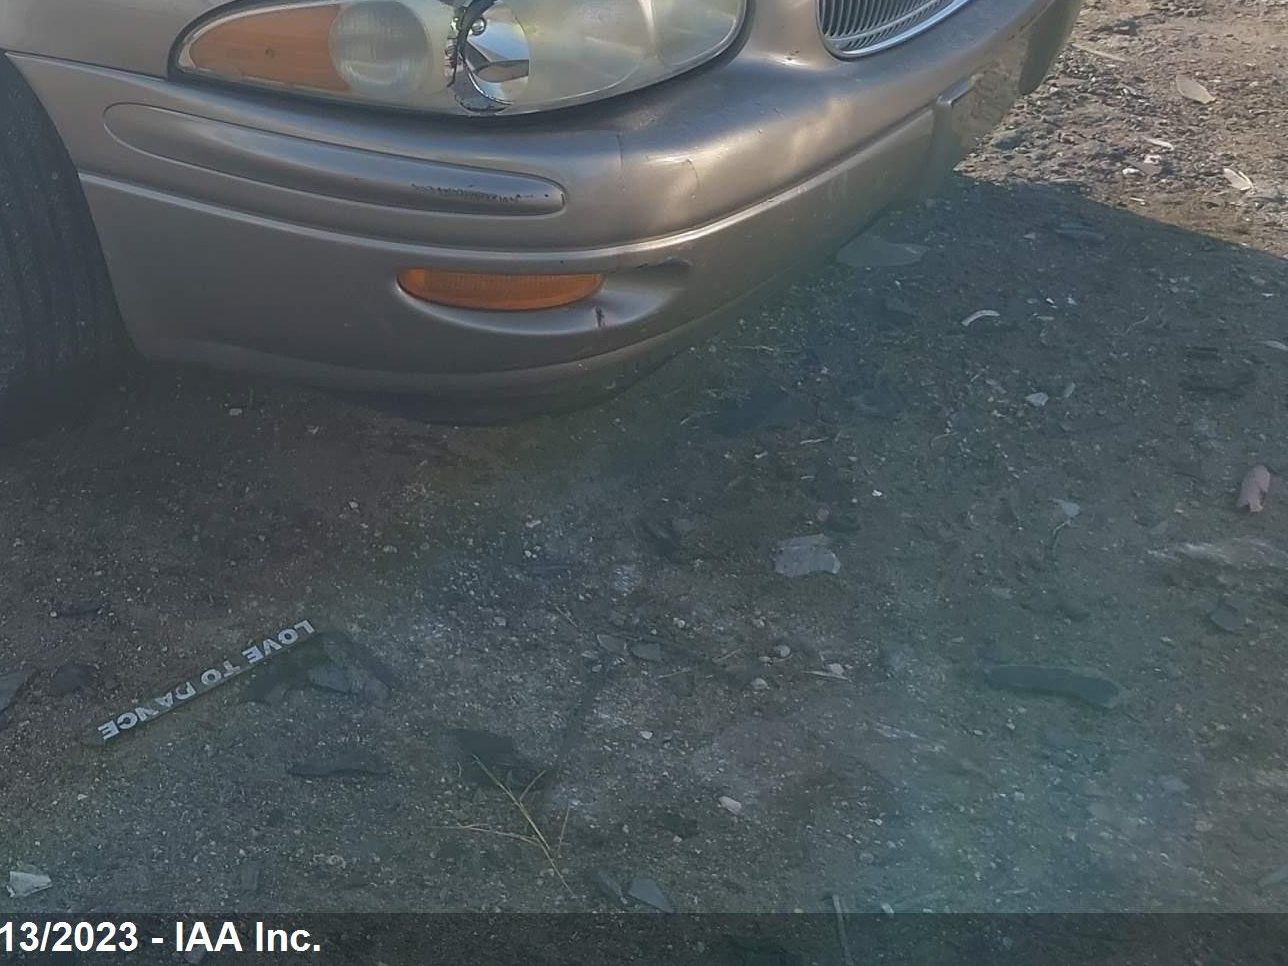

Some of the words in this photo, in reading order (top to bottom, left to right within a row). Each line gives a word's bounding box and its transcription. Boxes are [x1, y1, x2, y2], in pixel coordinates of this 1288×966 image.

[242, 619, 315, 664] LOVE
[201, 660, 241, 686] TO
[97, 682, 196, 740] DANCE
